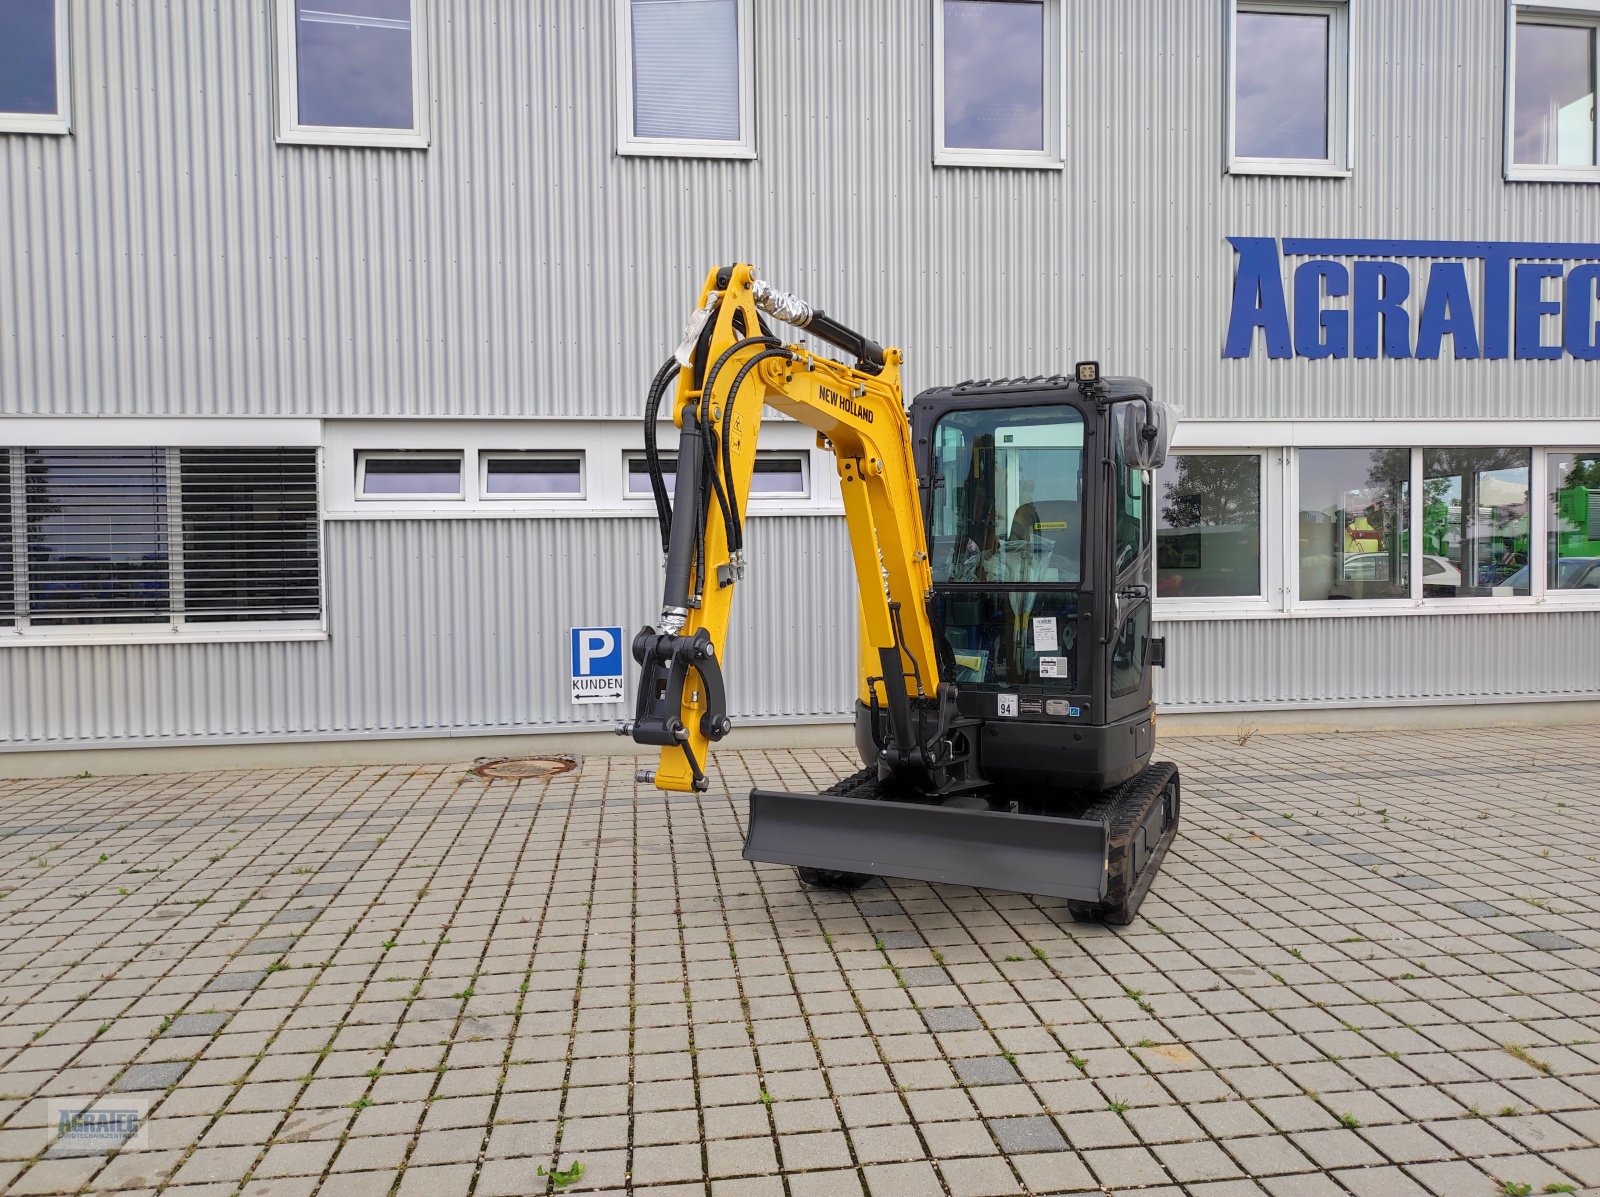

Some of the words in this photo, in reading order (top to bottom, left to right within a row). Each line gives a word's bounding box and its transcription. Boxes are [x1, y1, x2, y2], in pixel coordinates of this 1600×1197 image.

[819, 384, 838, 407] NEW
[839, 395, 874, 424] HOLLAND
[579, 630, 615, 675] P
[572, 678, 623, 690] KUNDEN
[1000, 703, 1011, 715] 94
